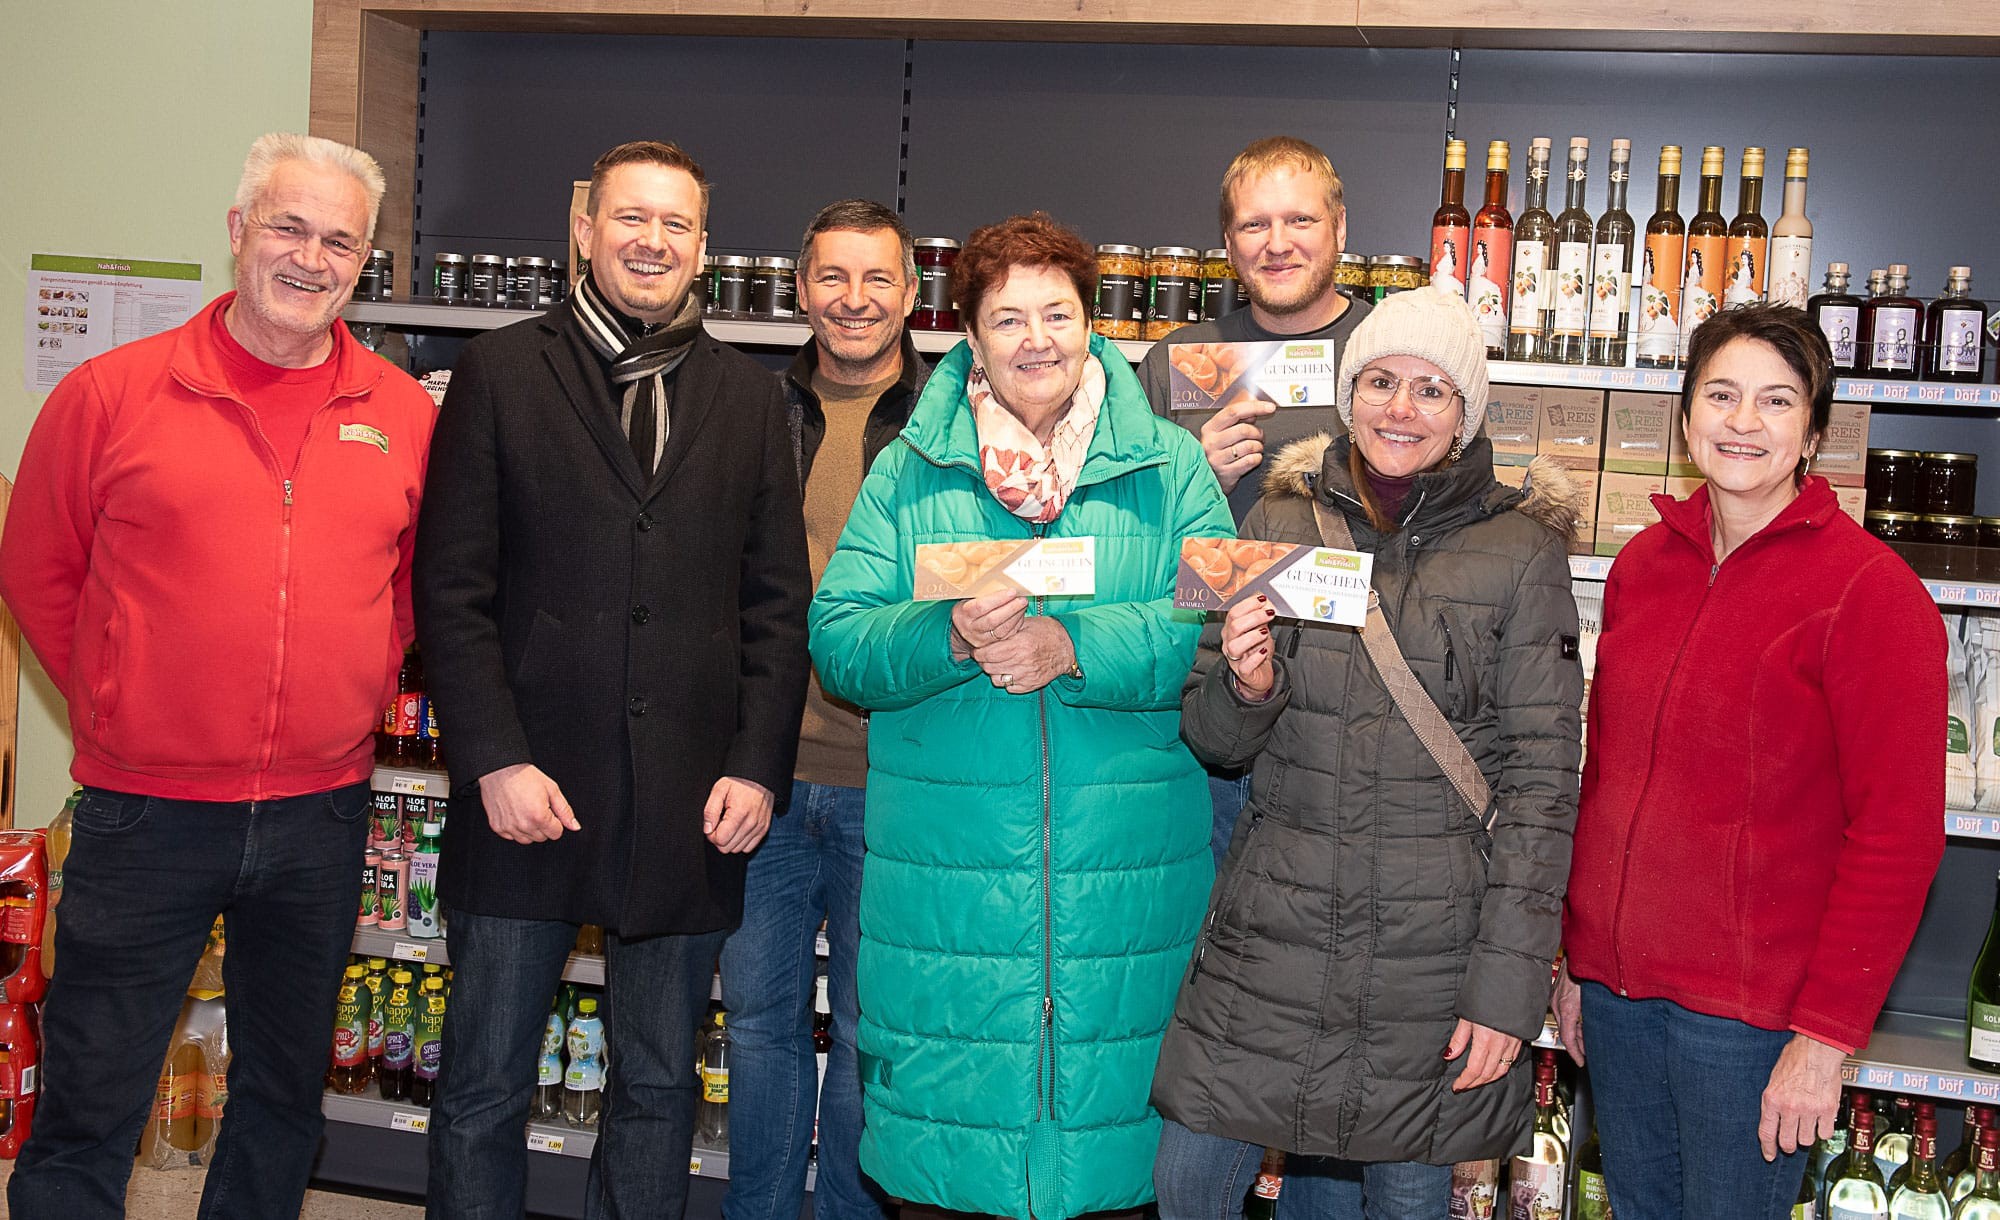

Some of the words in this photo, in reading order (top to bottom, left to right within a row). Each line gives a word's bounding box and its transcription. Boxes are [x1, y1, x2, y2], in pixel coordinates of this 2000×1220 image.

[1264, 363, 1332, 376] GUTSCHEIN
[1506, 408, 1534, 420] REIS
[1567, 412, 1596, 423] REIS
[1634, 416, 1664, 427] REIS
[1831, 428, 1860, 439] REIS
[1286, 569, 1368, 590] GUTSCHEIN
[1176, 587, 1210, 601] 100
[375, 794, 396, 802] ALOE
[406, 797, 425, 805] ALOE
[375, 802, 396, 810] VERA
[406, 804, 426, 812] VERA
[337, 1004, 360, 1014] appy
[384, 1004, 414, 1018] happy
[389, 1015, 407, 1027] day
[421, 1013, 443, 1026] hap
[428, 1024, 440, 1033] da
[412, 1120, 424, 1128] 1.45
